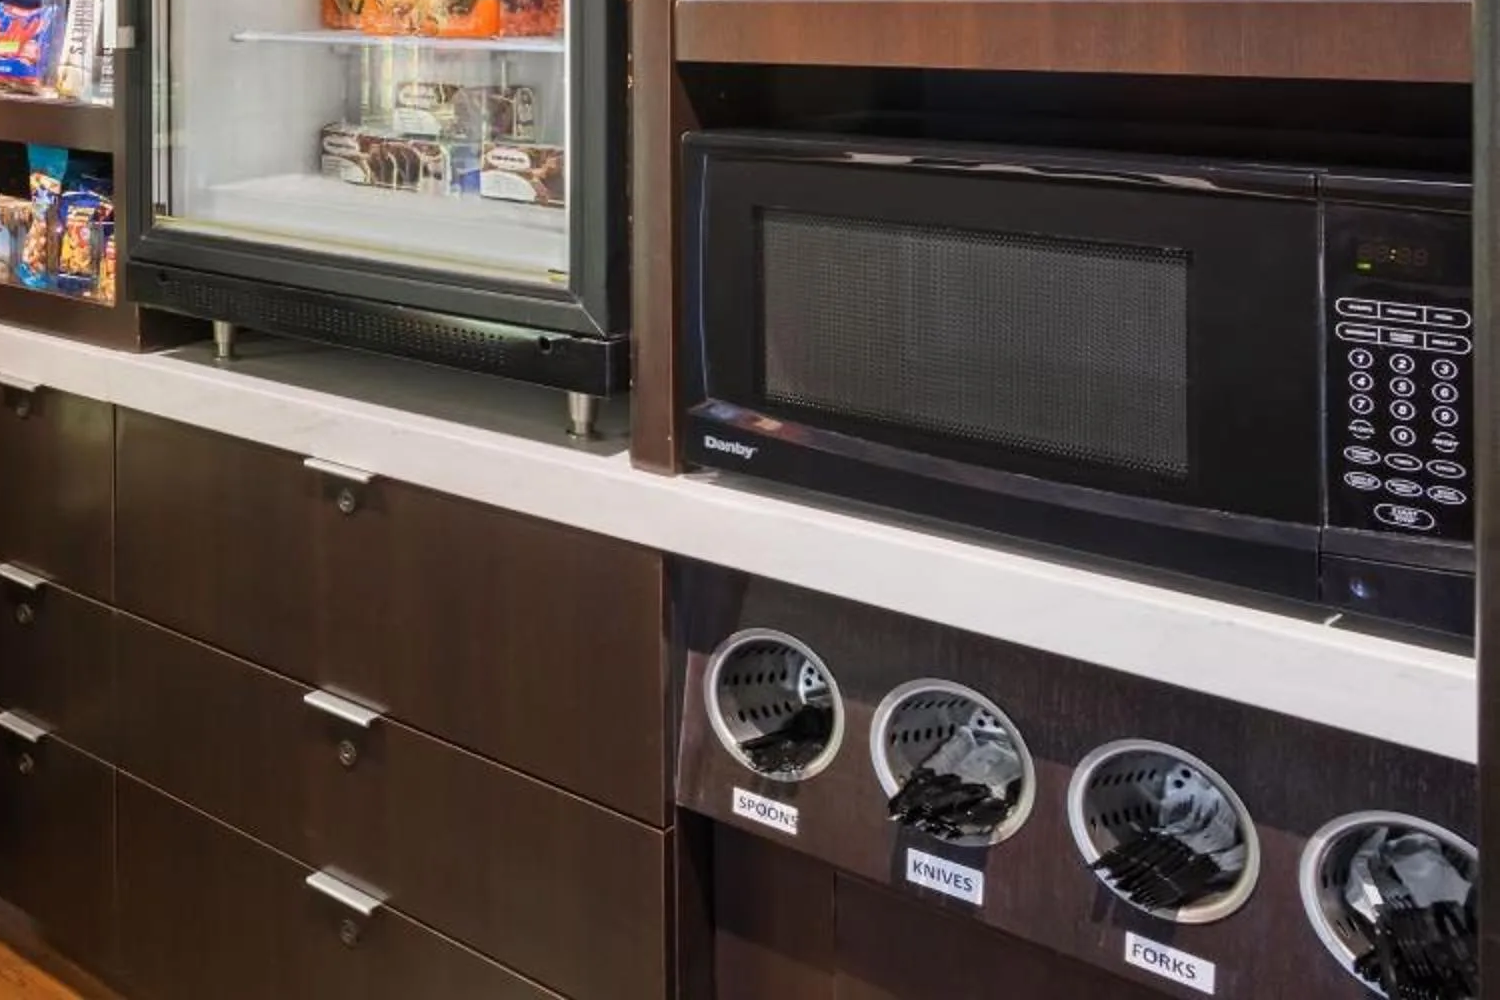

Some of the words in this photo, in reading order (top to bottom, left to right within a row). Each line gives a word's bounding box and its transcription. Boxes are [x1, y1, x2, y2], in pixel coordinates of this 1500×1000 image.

[1398, 359, 1407, 369] 2
[1440, 364, 1450, 375] 3
[1357, 377, 1366, 386] 4
[1440, 387, 1450, 398] 6
[1357, 399, 1366, 409] 7
[1398, 405, 1407, 415] 8
[1440, 411, 1450, 422] 9
[1398, 431, 1407, 441] 0
[704, 434, 753, 459] Danby
[737, 795, 798, 829] SPOONS
[911, 860, 974, 893] KNIVES
[1131, 943, 1197, 981] FORKS
